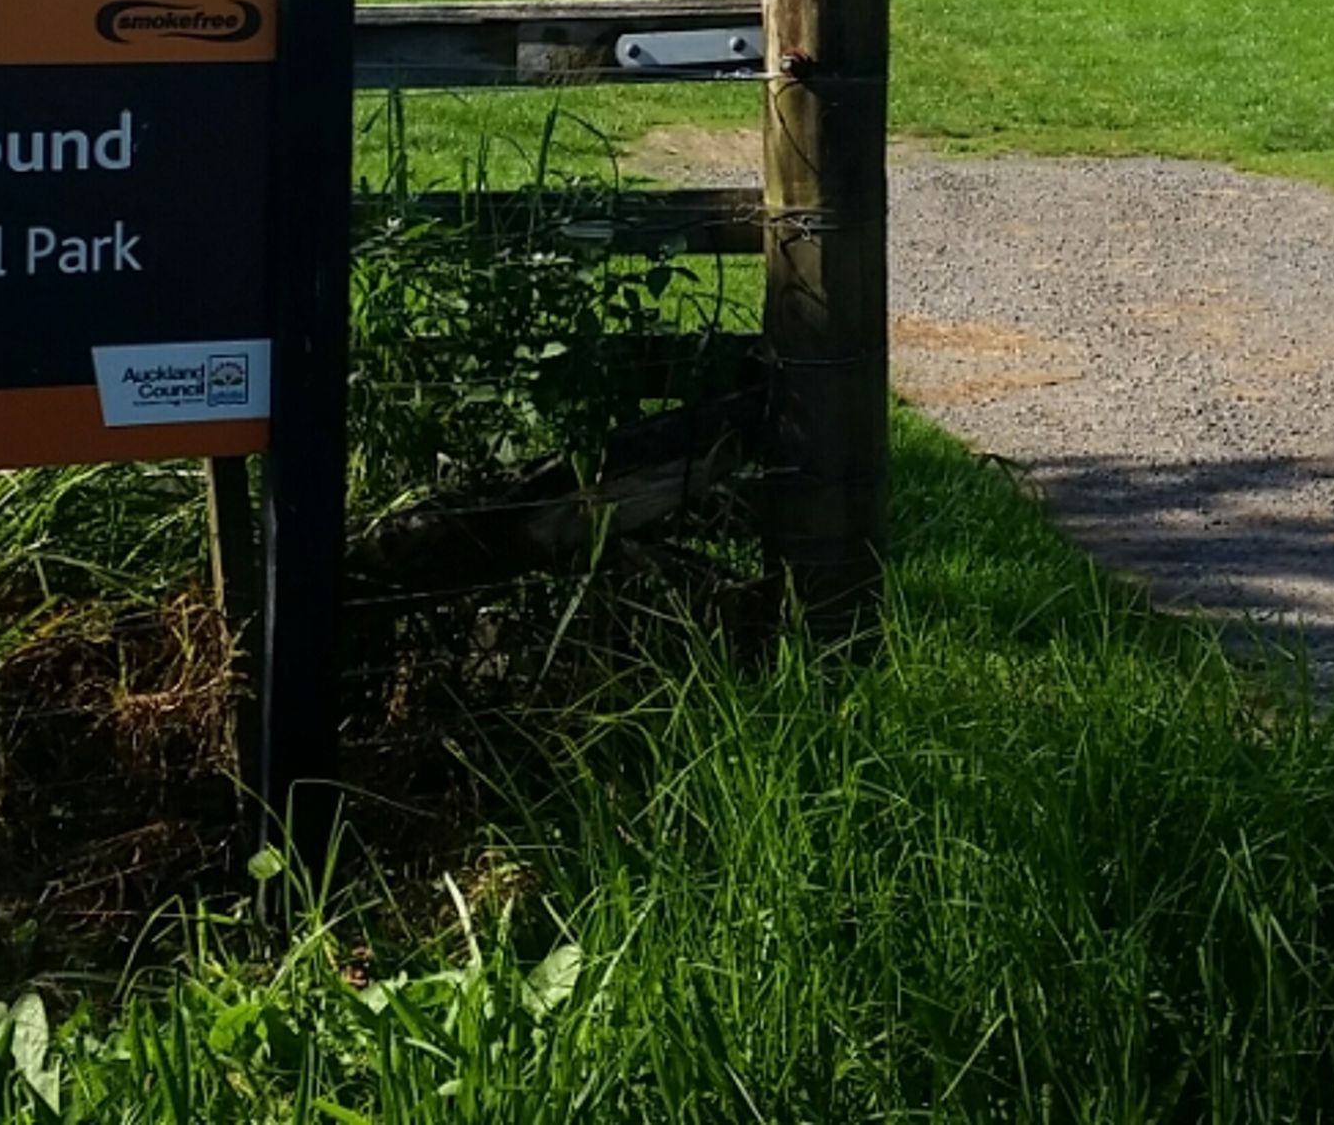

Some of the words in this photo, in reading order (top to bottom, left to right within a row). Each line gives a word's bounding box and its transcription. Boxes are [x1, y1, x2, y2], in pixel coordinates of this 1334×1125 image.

[117, 11, 239, 31] smokefree
[26, 220, 143, 275] Park
[121, 362, 205, 384] Auckland
[138, 381, 205, 399] Council
